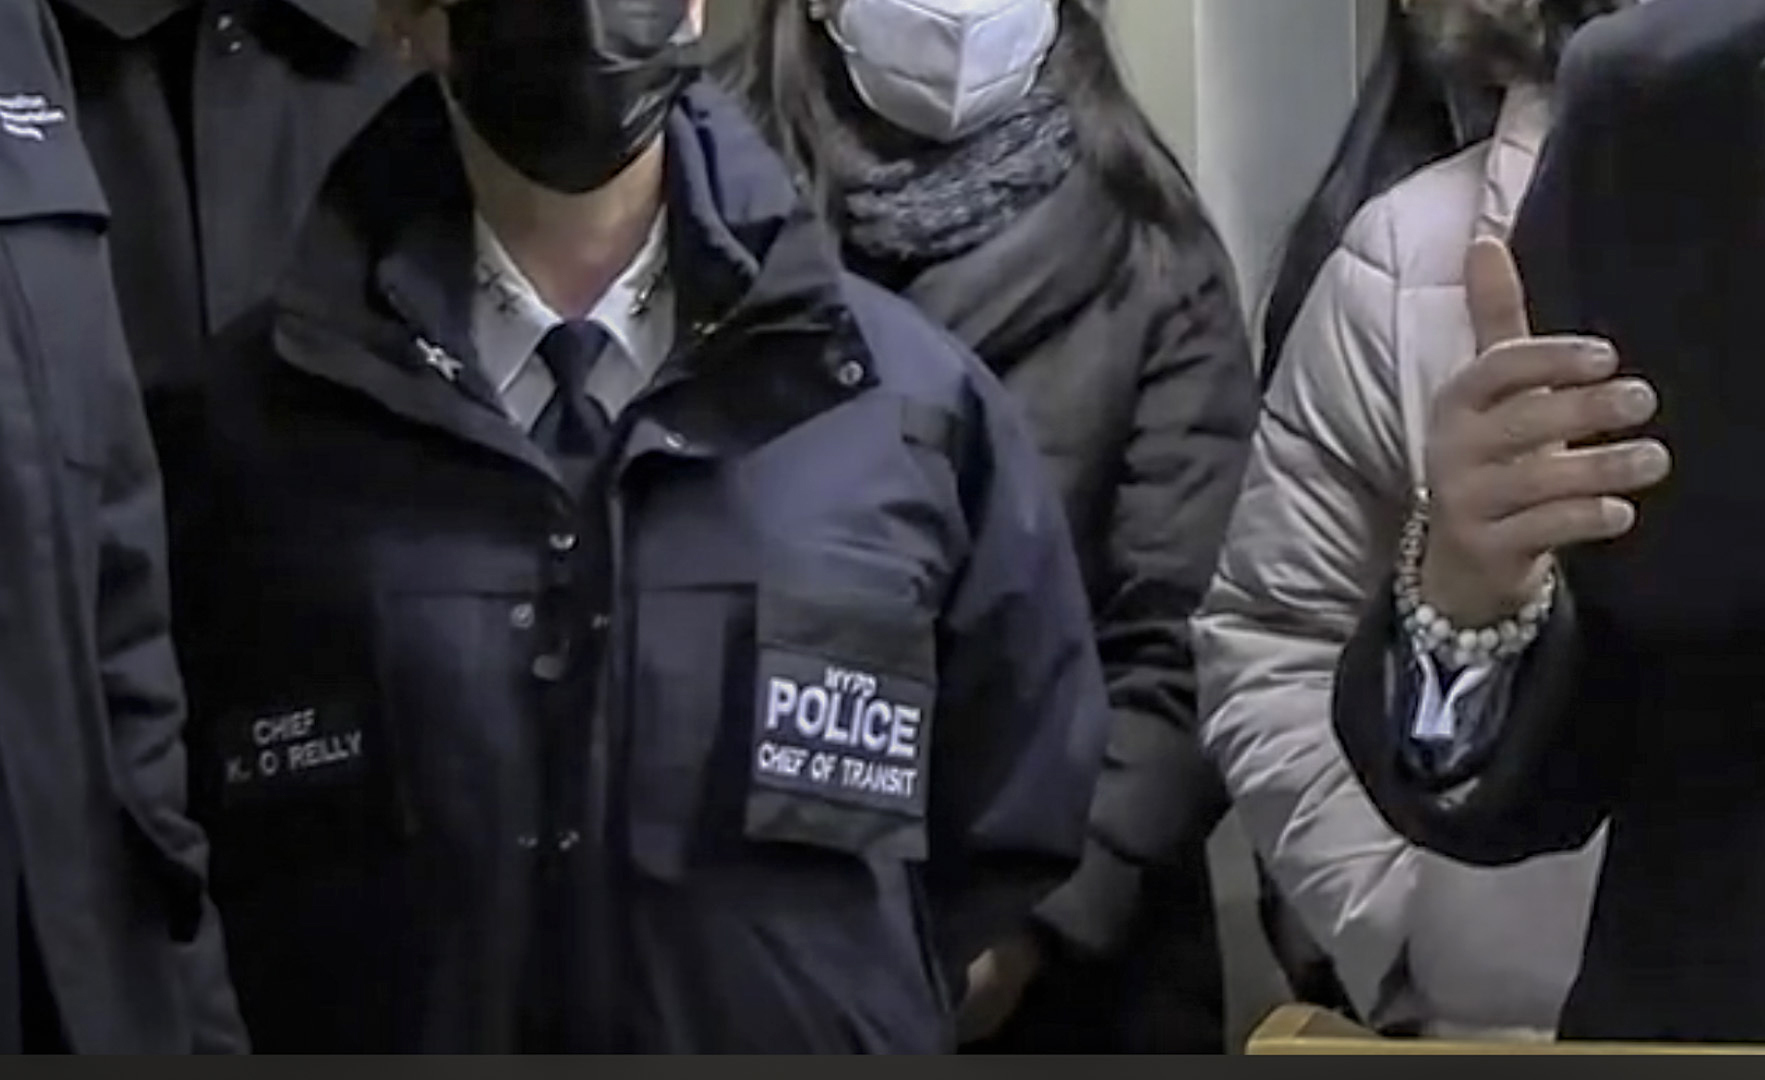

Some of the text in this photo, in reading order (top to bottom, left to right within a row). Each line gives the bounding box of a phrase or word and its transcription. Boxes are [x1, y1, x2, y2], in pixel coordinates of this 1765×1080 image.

[824, 666, 877, 699] NYPD
[252, 707, 316, 748] CHIEF
[764, 675, 921, 758] POLICE
[758, 741, 919, 798] CHIEF OF TRANSIT
